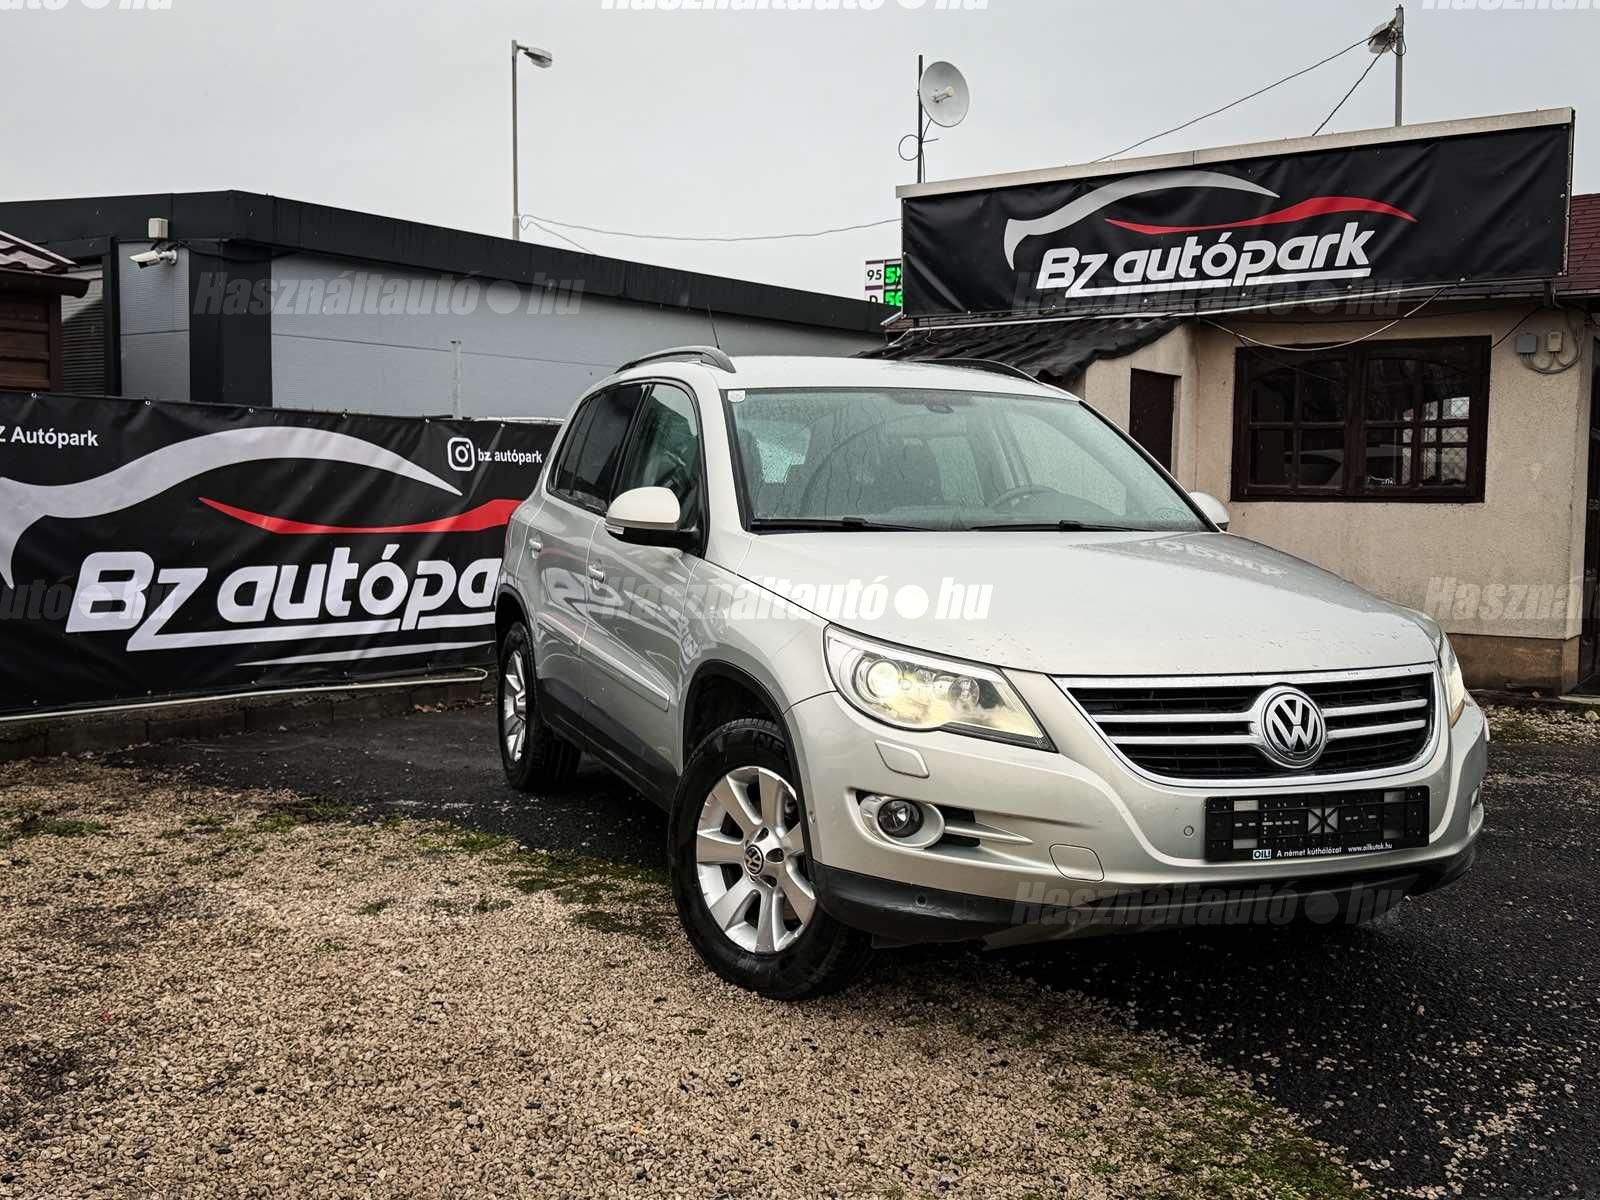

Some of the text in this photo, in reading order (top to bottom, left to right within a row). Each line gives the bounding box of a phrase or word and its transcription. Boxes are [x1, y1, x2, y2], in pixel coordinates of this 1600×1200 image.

[1113, 222, 1375, 287] autópark
[867, 269, 882, 281] 95
[10, 425, 99, 449] Autópark
[494, 449, 543, 466] autópark
[1276, 850, 1283, 858] A
